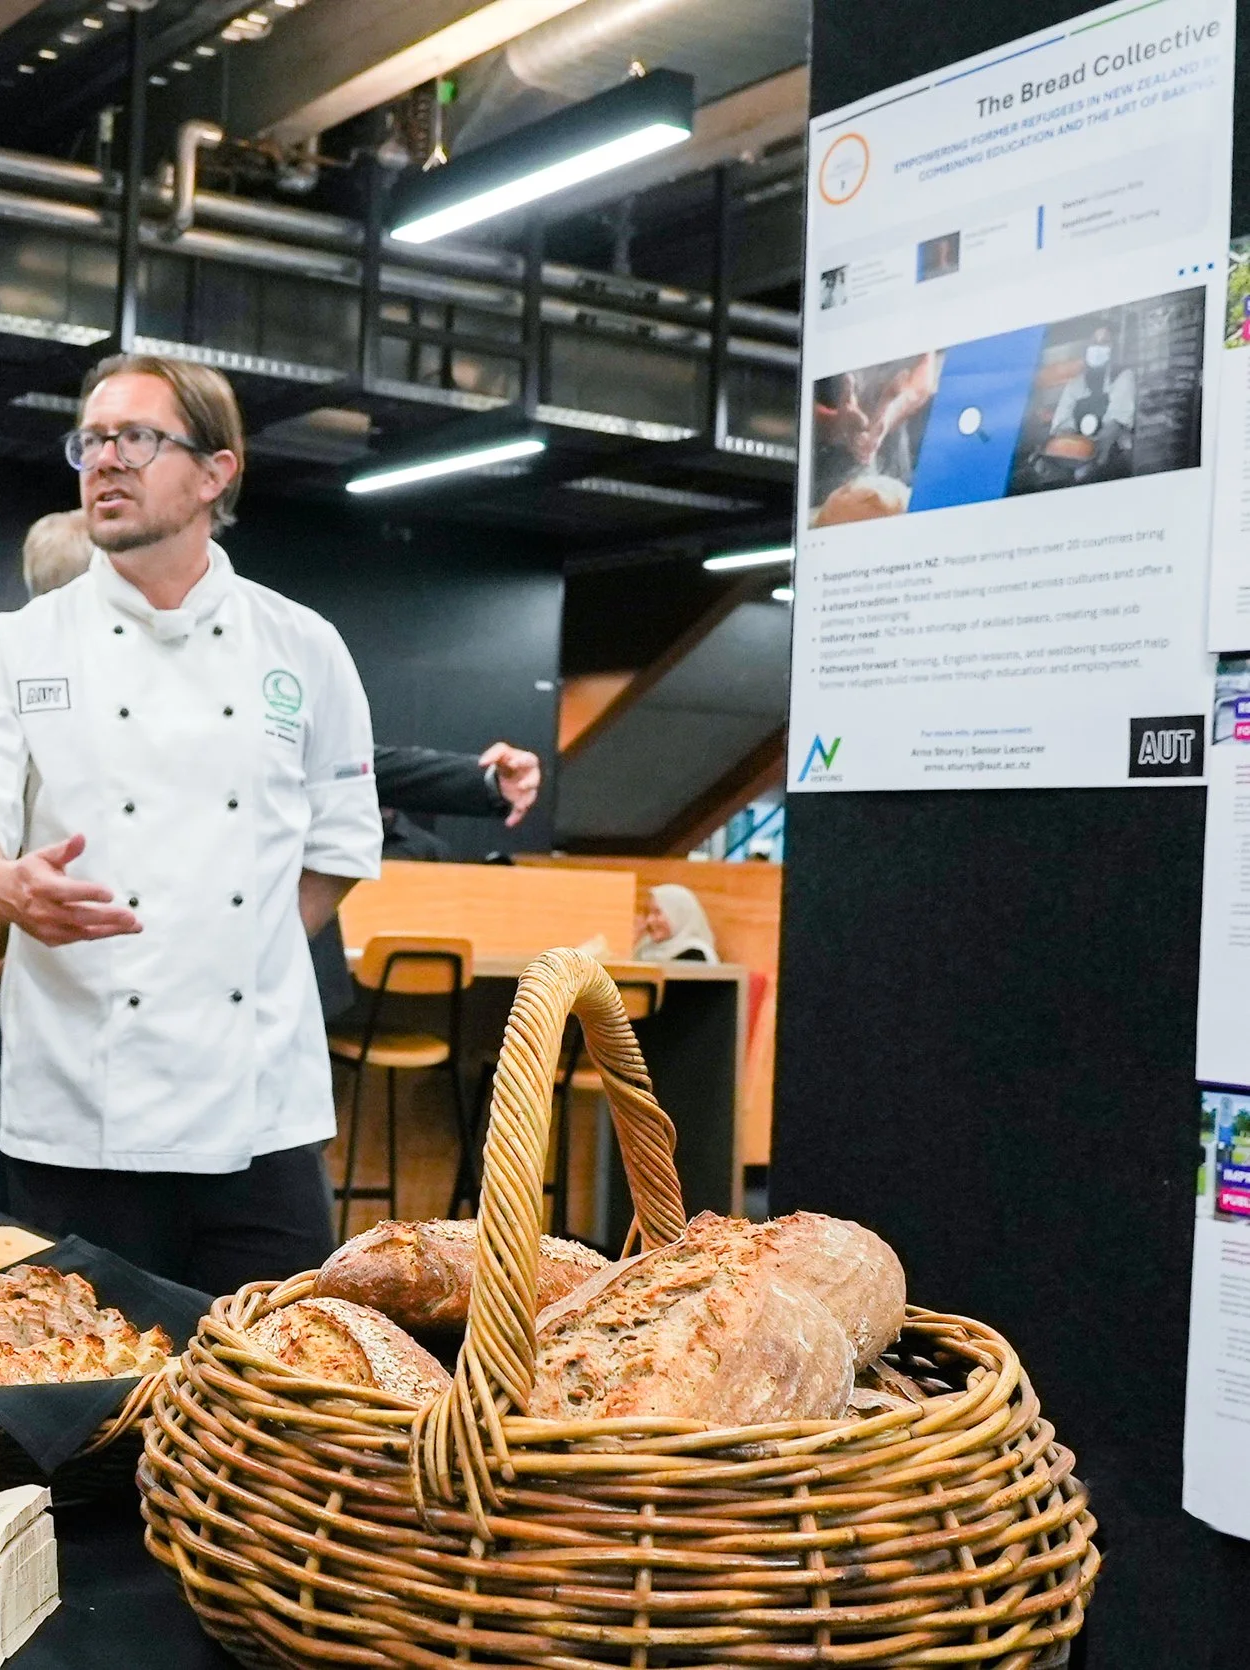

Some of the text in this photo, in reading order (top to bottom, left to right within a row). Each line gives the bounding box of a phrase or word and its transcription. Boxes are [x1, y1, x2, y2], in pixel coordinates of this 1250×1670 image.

[976, 20, 1221, 118] The Bread Collective
[893, 139, 968, 173] EMPOWERING
[971, 121, 1018, 145] FORMER
[1020, 100, 1084, 129] REFUGEES
[1086, 95, 1100, 108] IN
[1103, 83, 1133, 101] NEW
[1137, 61, 1199, 92] ZEALAND
[918, 151, 984, 182] COMBINING
[986, 128, 1054, 159] EDUCATION
[1057, 118, 1084, 136] AND
[1087, 108, 1111, 127] THE
[1113, 99, 1138, 117] ART
[1140, 92, 1158, 108] OF
[822, 567, 869, 583] Supporting
[872, 561, 910, 576] refugees
[913, 560, 922, 569] in
[944, 554, 976, 567] People
[980, 548, 1014, 563] arriving
[1017, 545, 1039, 556] from
[1043, 542, 1064, 553] over
[1066, 538, 1080, 551] 20
[1082, 534, 1133, 548] countries
[1136, 528, 1165, 542] bring
[821, 603, 827, 612] A
[828, 599, 858, 612] shared
[903, 591, 931, 603] Bread
[933, 589, 951, 600] and
[953, 585, 985, 598] baking
[988, 581, 1028, 594] connect
[1031, 577, 1063, 590] across
[1066, 571, 1110, 586] cultures
[1113, 568, 1134, 580] and
[1137, 564, 1163, 577] offer
[1165, 564, 1173, 574] a
[876, 580, 892, 591] and
[820, 632, 856, 645] Industry
[899, 625, 915, 635] has
[925, 621, 967, 635] shortage
[970, 618, 980, 629] of
[982, 615, 1014, 628] skilled
[1055, 607, 1098, 622] creating
[1100, 604, 1120, 616] real
[1122, 602, 1140, 617] job
[819, 662, 860, 675] Pathways
[943, 653, 977, 667] English
[1025, 647, 1044, 659] and
[1047, 643, 1097, 658] wellbeing
[1099, 639, 1142, 653] support
[1144, 636, 1170, 650] help
[954, 668, 993, 682] through
[995, 664, 1046, 678] education
[1049, 662, 1068, 674] and
[26, 687, 62, 705] AUT
[910, 747, 932, 757] Arno
[971, 745, 1002, 756] Senior
[1003, 743, 1046, 755] Lecturer
[1137, 728, 1196, 765] AUT
